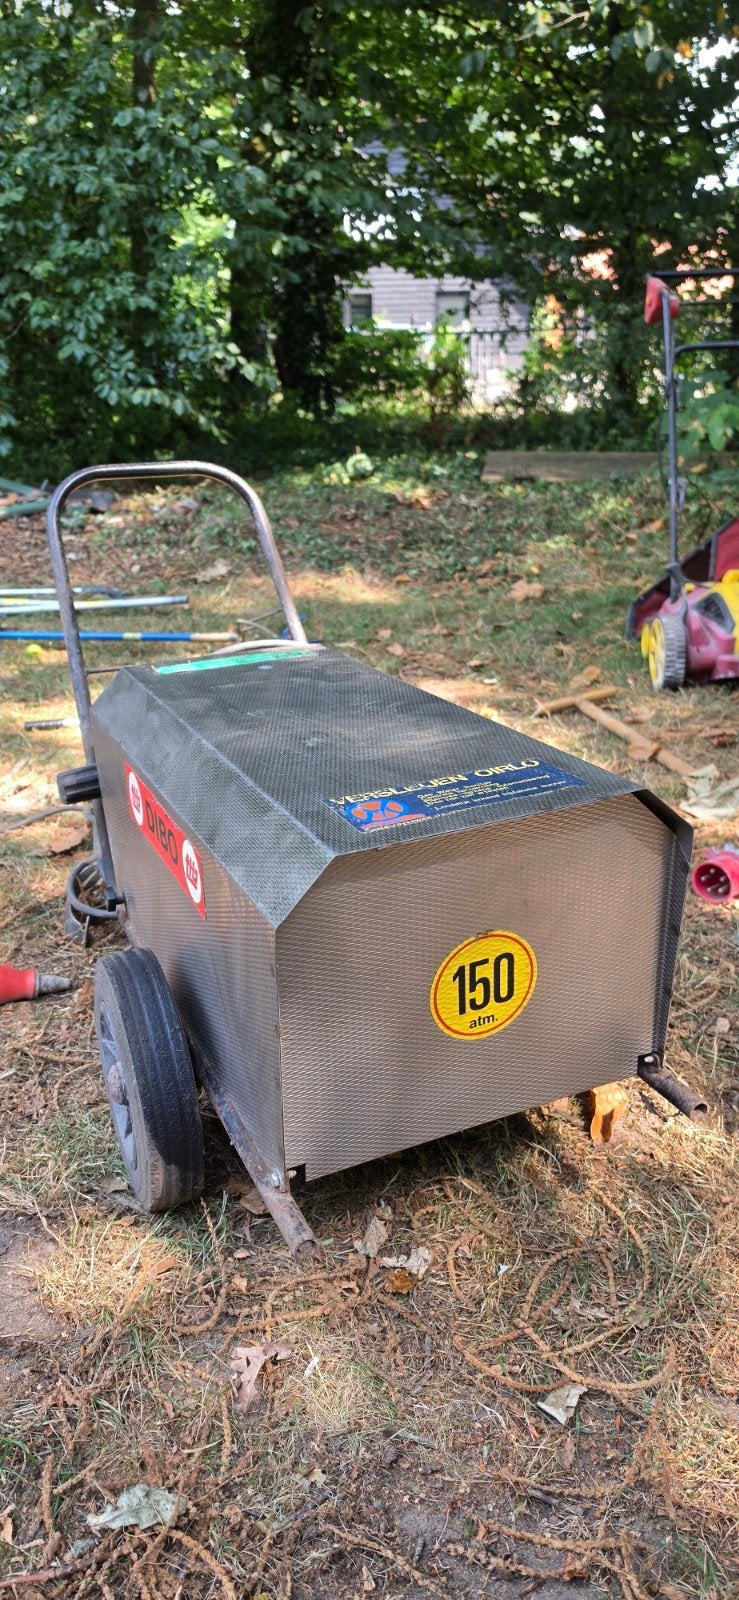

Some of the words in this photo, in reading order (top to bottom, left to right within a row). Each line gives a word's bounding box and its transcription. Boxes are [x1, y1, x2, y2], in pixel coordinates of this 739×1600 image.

[474, 759, 540, 776] OIRLO
[145, 800, 179, 865] DIBO
[452, 952, 515, 1015] 150
[469, 1013, 499, 1029] atm.
